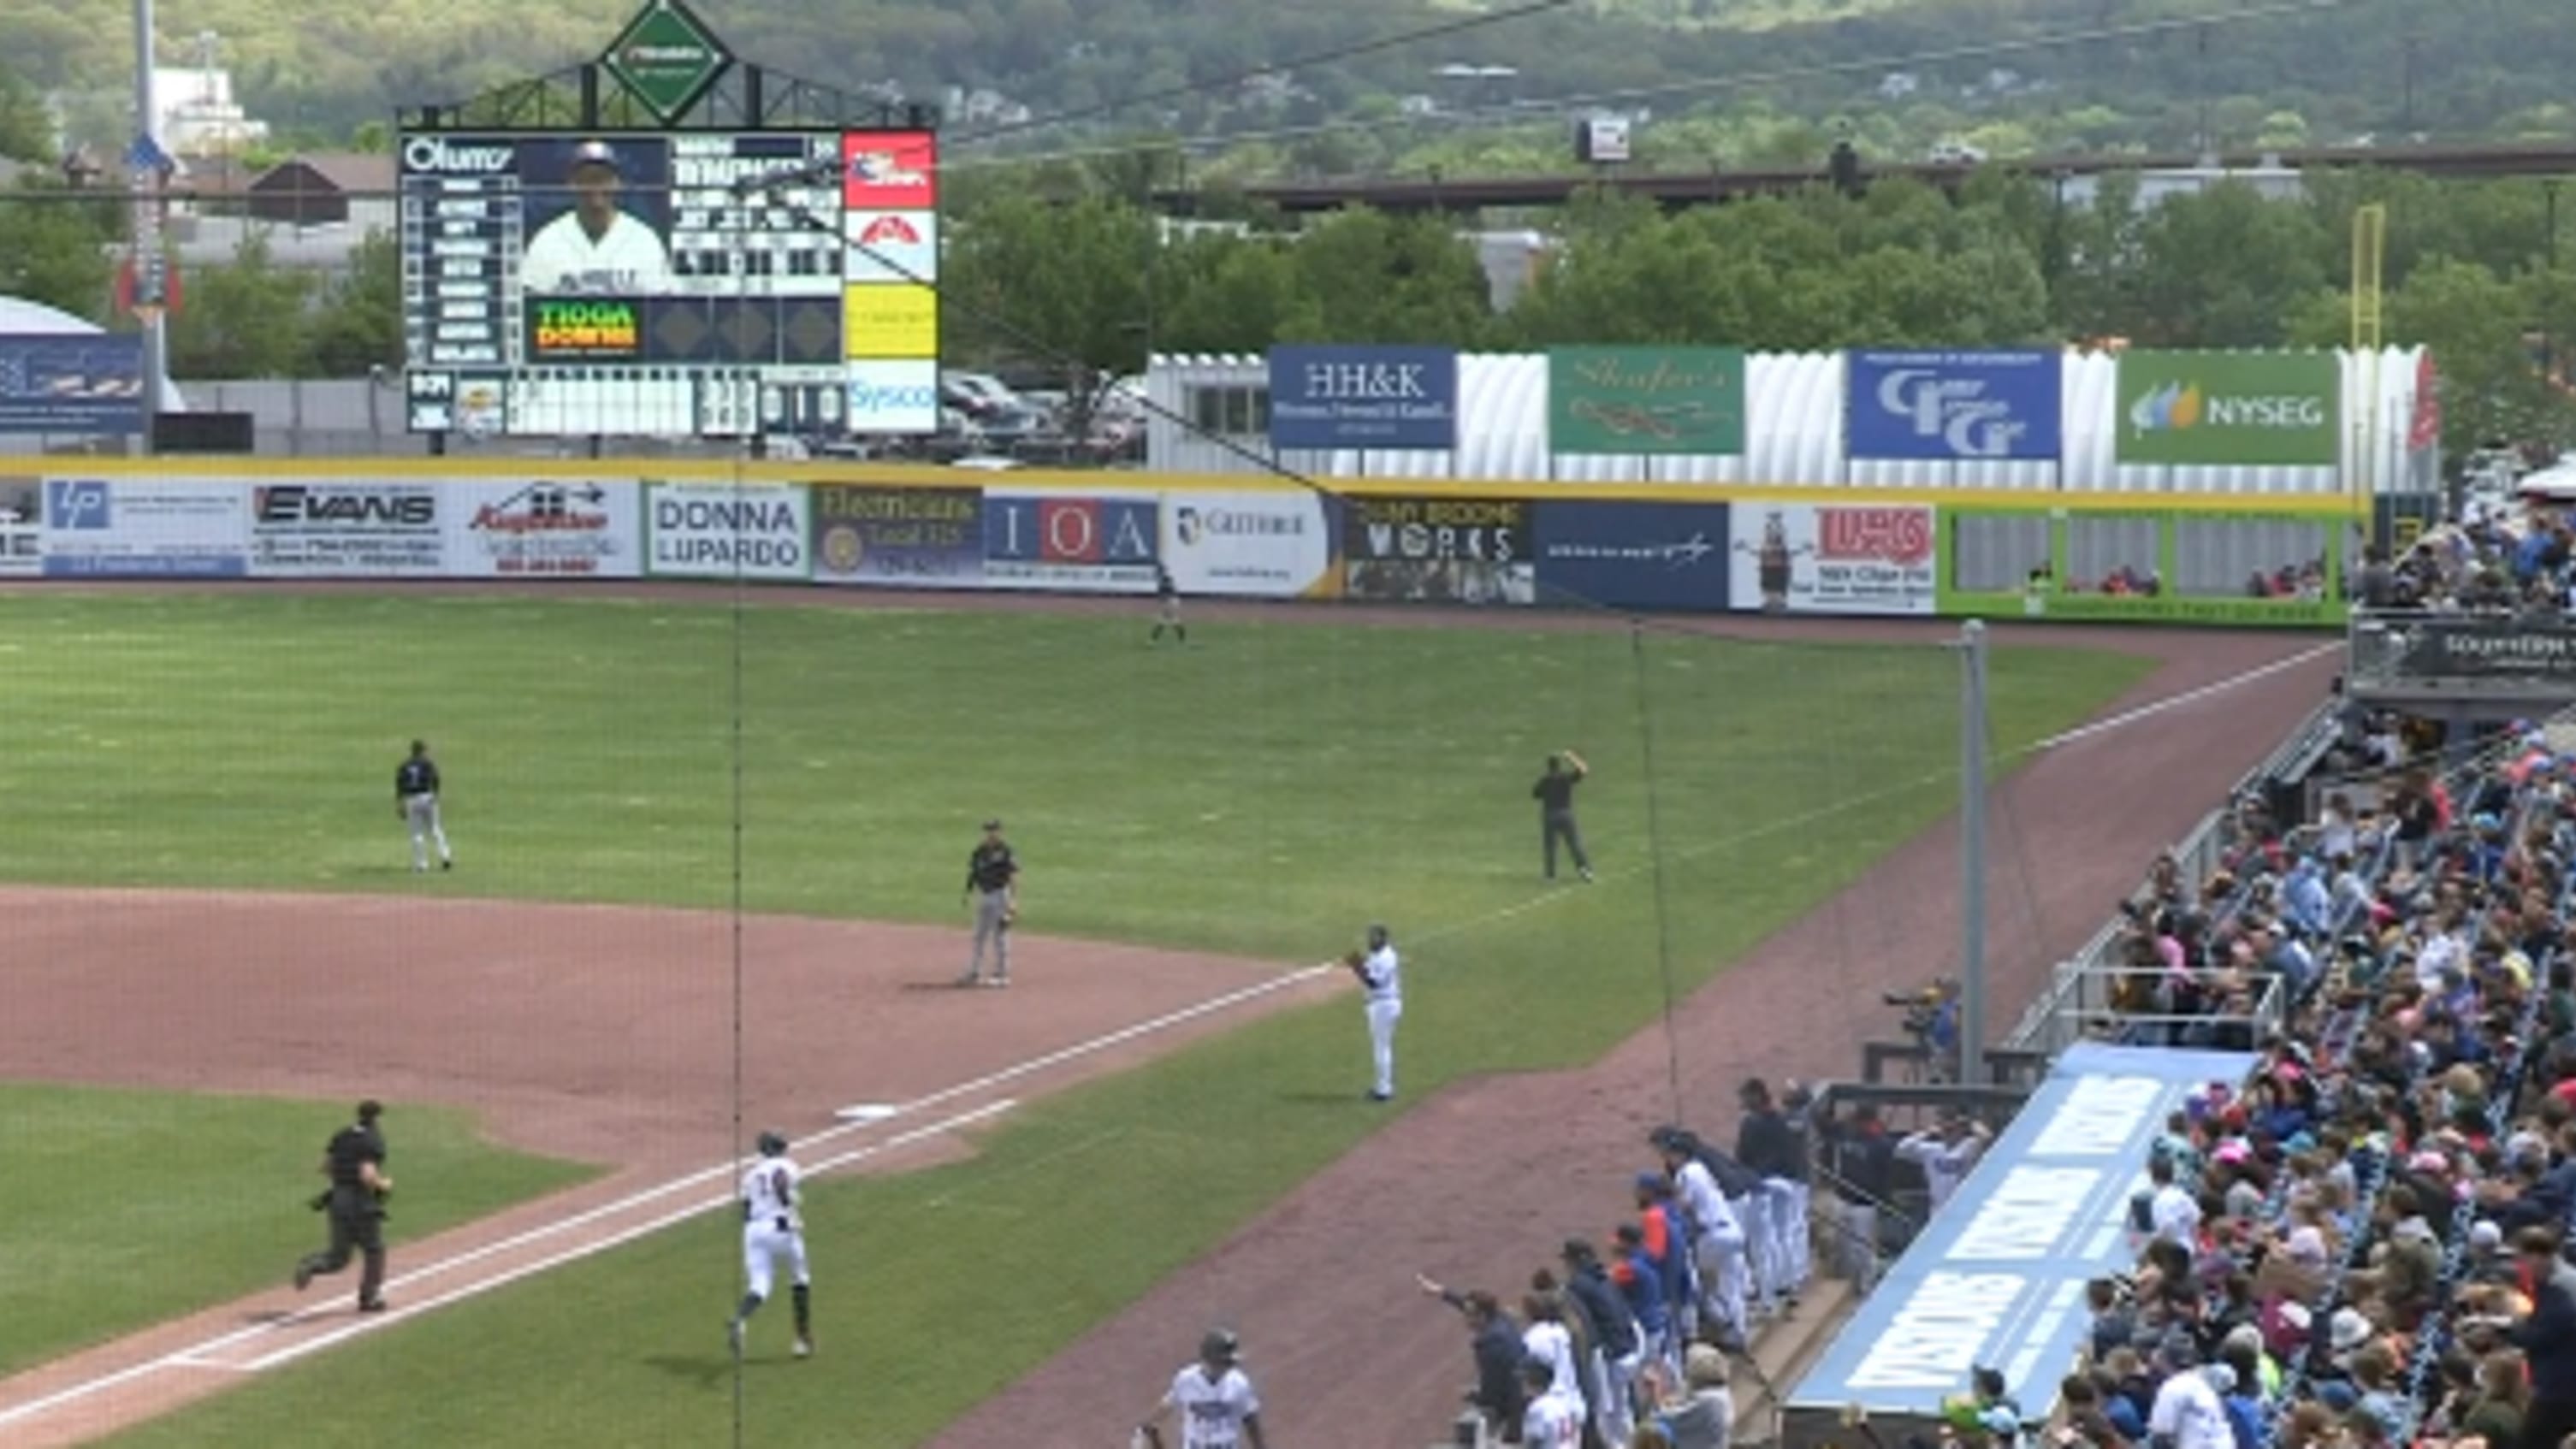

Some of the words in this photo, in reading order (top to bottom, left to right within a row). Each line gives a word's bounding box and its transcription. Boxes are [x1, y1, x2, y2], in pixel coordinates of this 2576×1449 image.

[538, 302, 632, 325] TIOGA
[849, 380, 934, 412] Sysco
[1305, 363, 1426, 399] HH&K
[2206, 395, 2324, 426] NYSEG
[253, 486, 435, 523] EVANS
[656, 500, 799, 533] DONNA
[656, 538, 801, 566] LUPARDO
